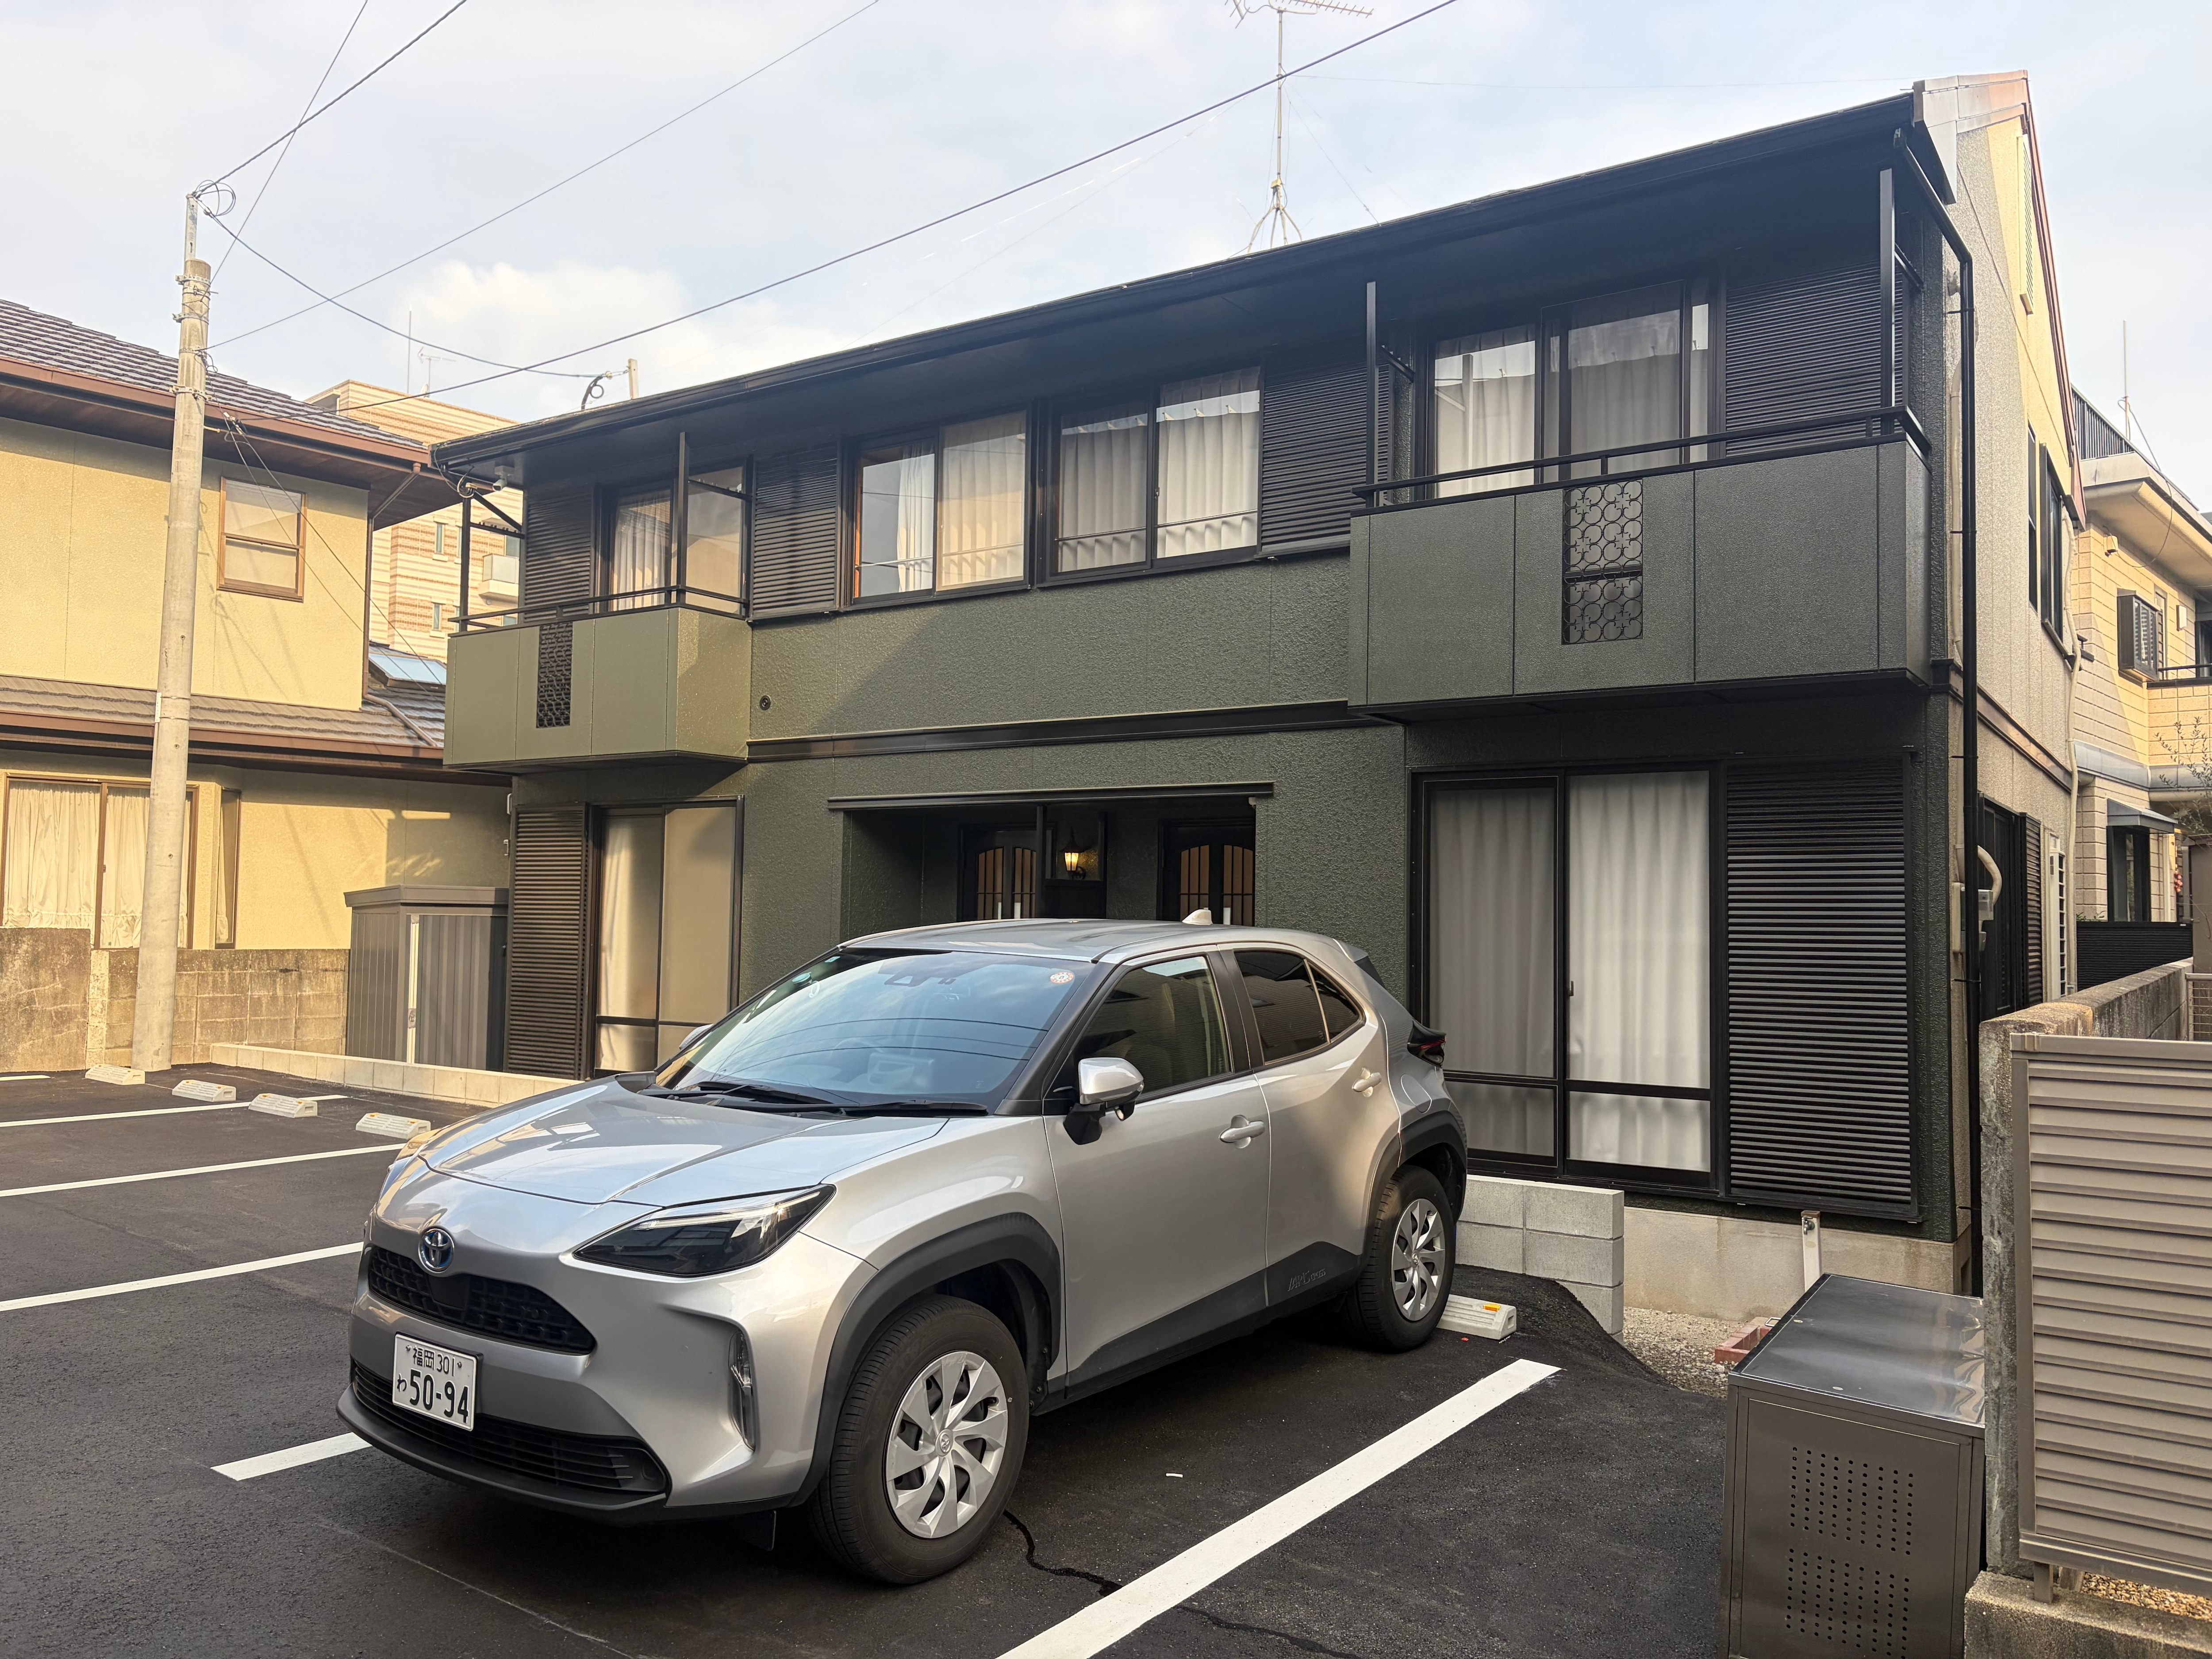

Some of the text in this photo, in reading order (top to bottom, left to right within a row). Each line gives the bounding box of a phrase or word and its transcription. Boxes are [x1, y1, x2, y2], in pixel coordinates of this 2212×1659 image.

[413, 1345, 455, 1377] 福岡 301
[397, 1369, 469, 1424] わ 50-94
